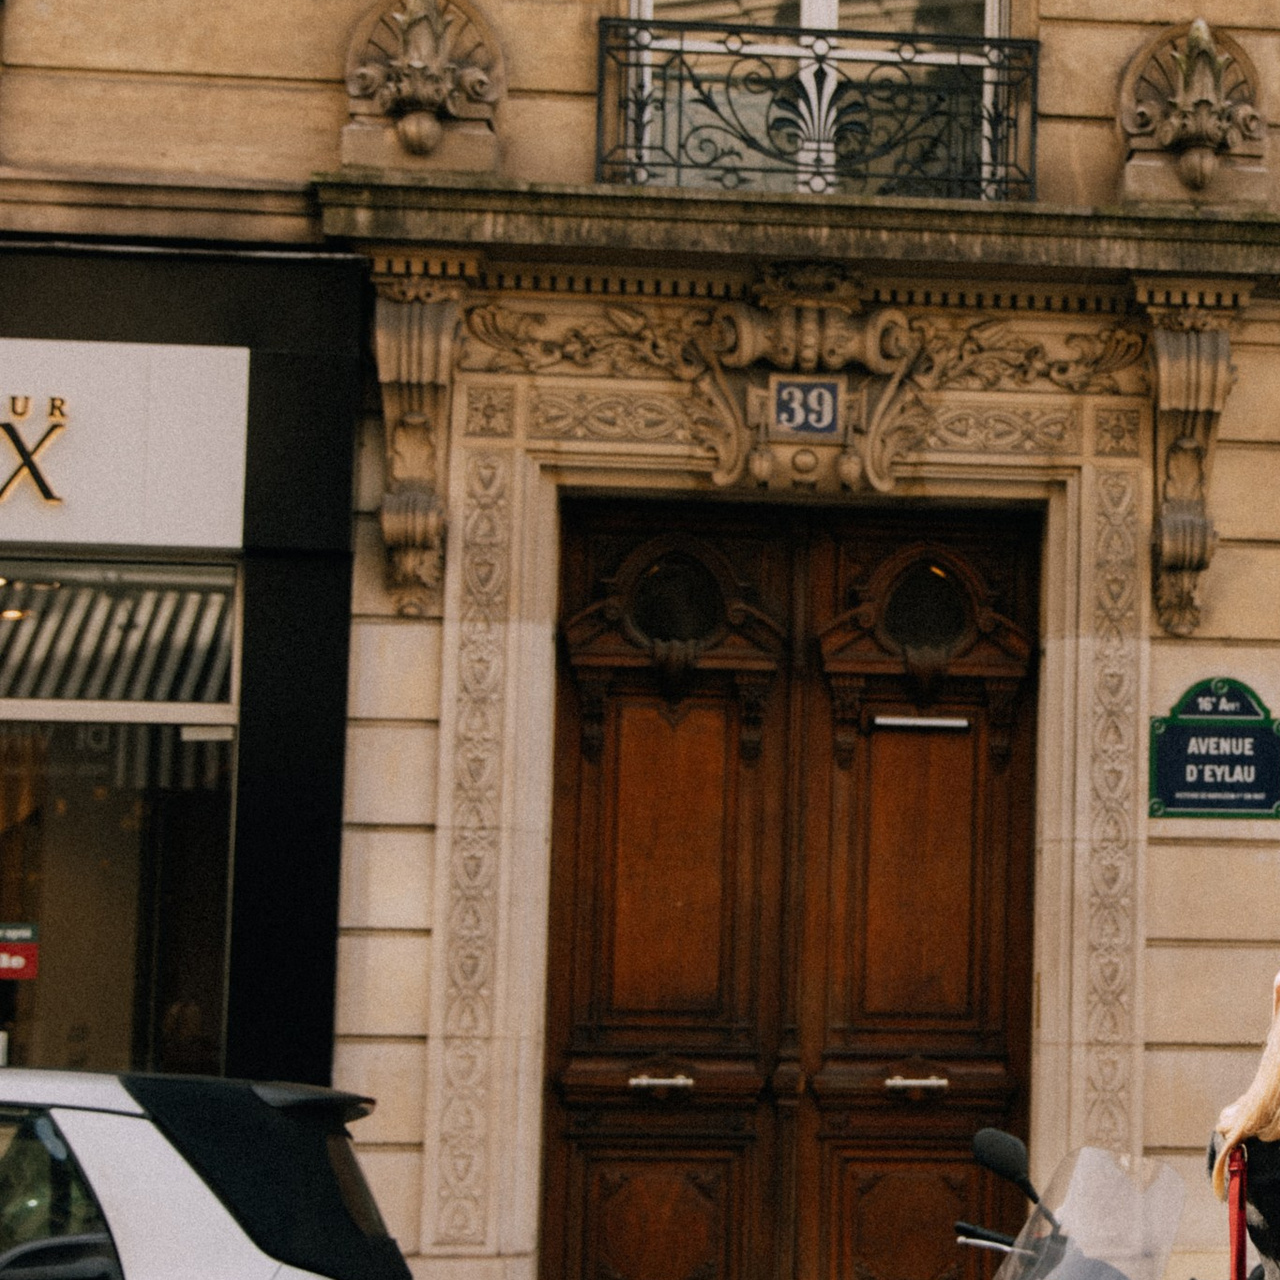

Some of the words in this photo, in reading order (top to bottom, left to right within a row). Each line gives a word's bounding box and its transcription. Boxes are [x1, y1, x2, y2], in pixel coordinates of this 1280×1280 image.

[780, 386, 834, 429] 39
[1187, 736, 1254, 755] AVENUE
[1185, 764, 1256, 783] D'EYLAU
